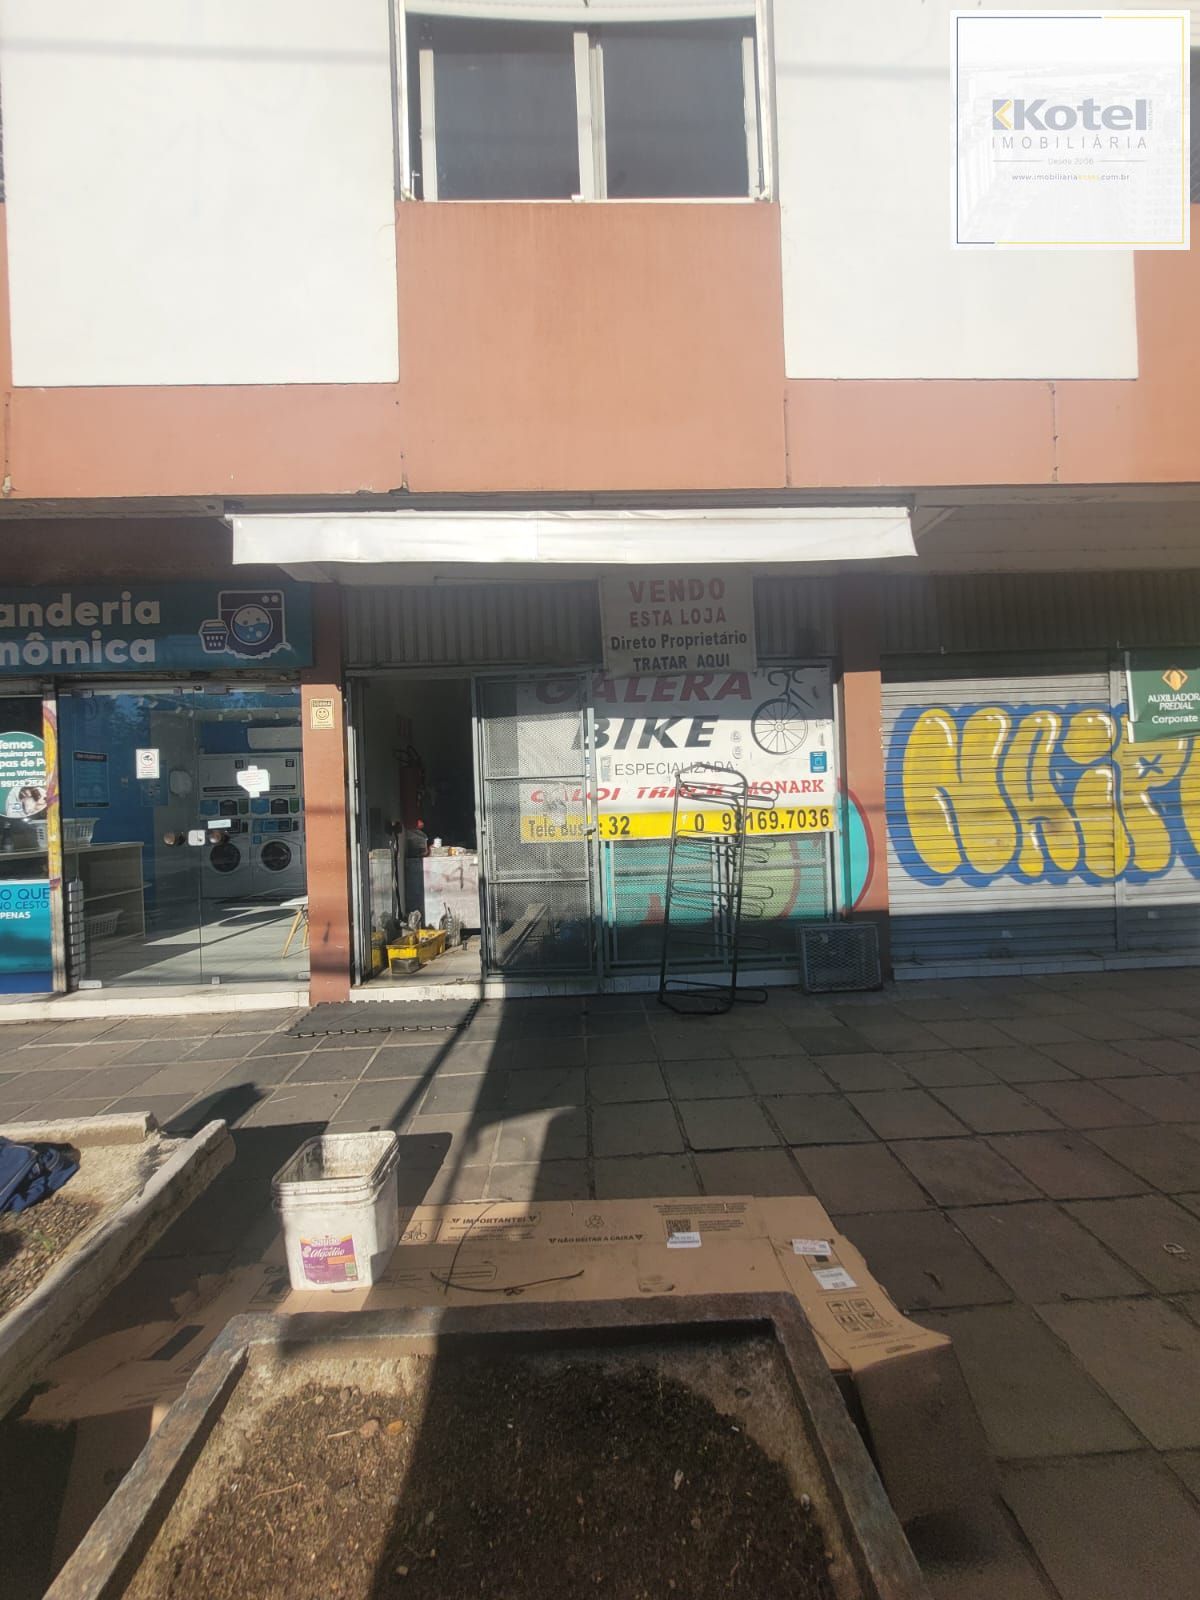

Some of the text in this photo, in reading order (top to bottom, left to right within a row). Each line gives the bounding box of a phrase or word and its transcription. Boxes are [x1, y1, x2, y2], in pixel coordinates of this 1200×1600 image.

[628, 577, 726, 603] VENDO
[0, 591, 161, 627] anderia
[629, 607, 727, 628] ESTA LOJA
[0, 630, 156, 666] nômica
[610, 630, 748, 651] Direto Proprietário
[632, 653, 730, 672] TRATAR AQUI
[535, 670, 753, 704] GALERA
[1148, 693, 1200, 703] AUXILIADOR
[1151, 714, 1198, 725] Corporate
[570, 714, 720, 751] BIKE
[20, 758, 35, 767] de
[530, 786, 621, 804] CLOI
[608, 815, 631, 836] 32
[721, 807, 831, 833] 9169.7036
[18, 887, 50, 899] QUE
[0, 901, 49, 910] O CESTO
